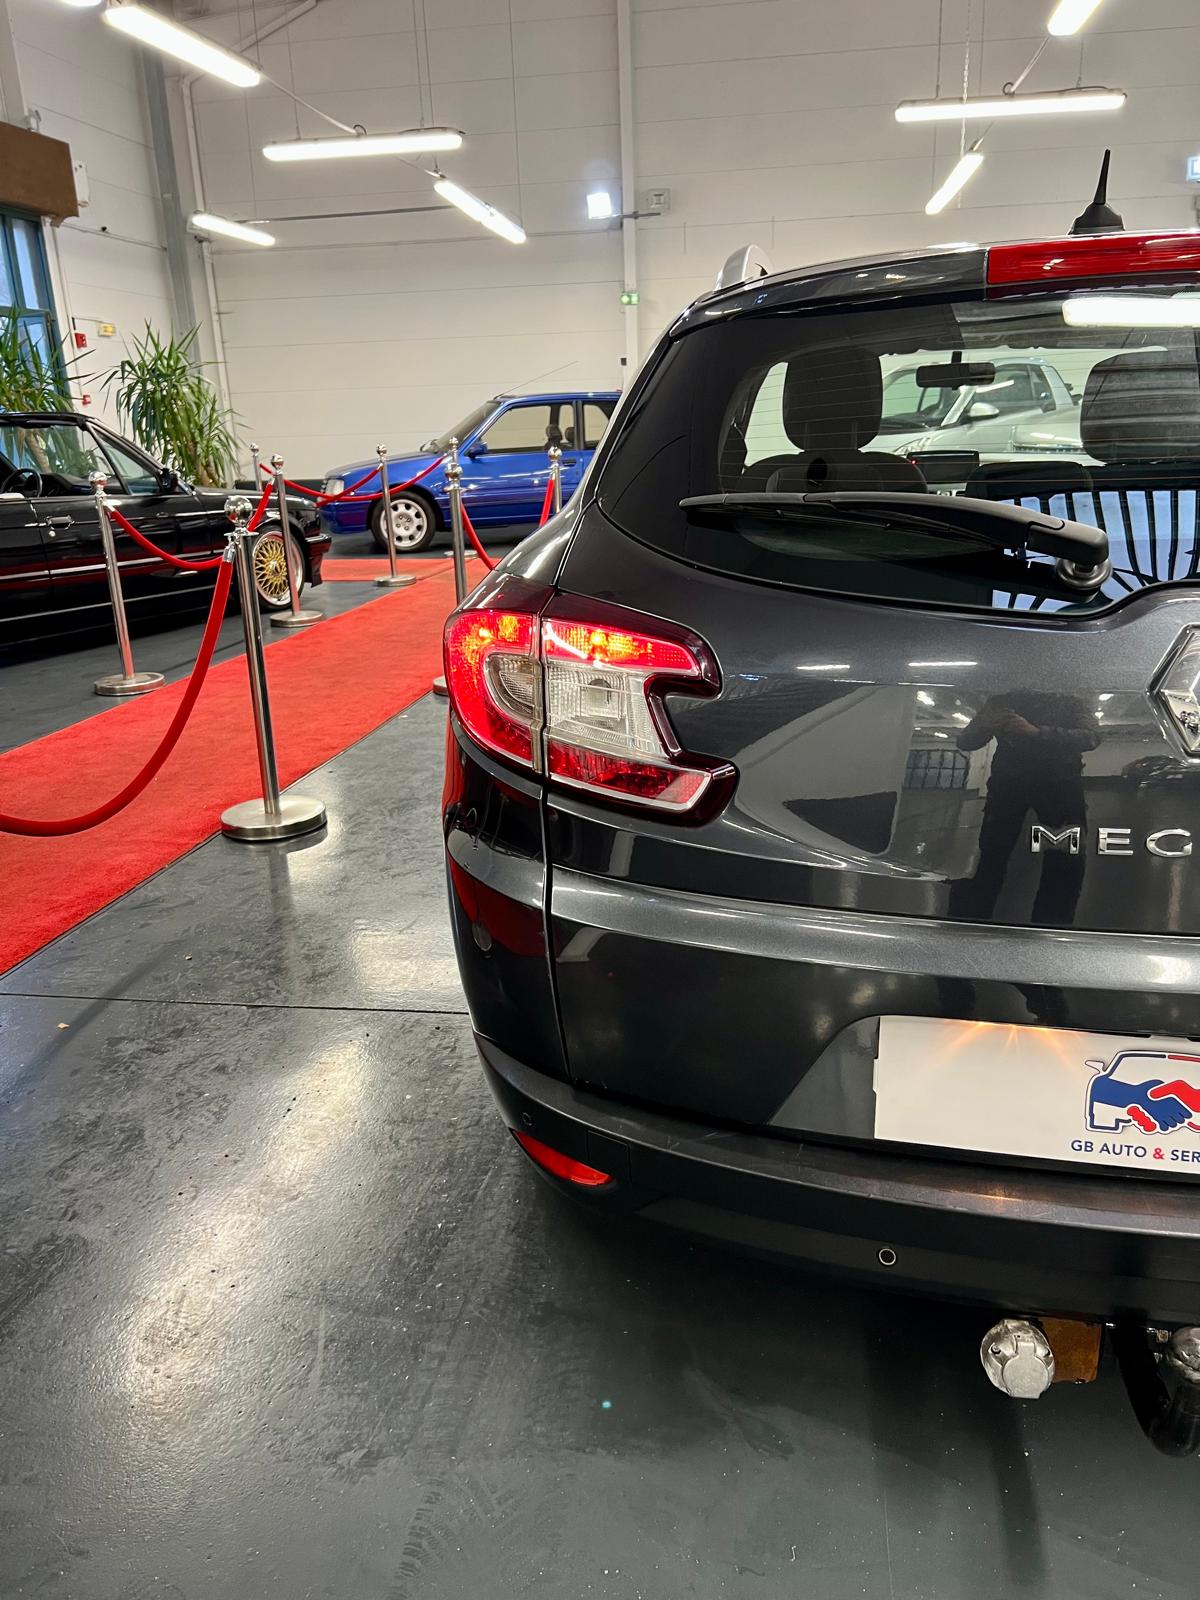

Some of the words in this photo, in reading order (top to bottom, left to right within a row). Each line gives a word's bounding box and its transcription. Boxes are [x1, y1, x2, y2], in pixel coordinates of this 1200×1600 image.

[1031, 825, 1193, 858] MEG
[1071, 1139, 1094, 1153] GB
[1099, 1142, 1147, 1158] AUTO
[1152, 1147, 1165, 1160] &
[1170, 1149, 1200, 1163] SER
